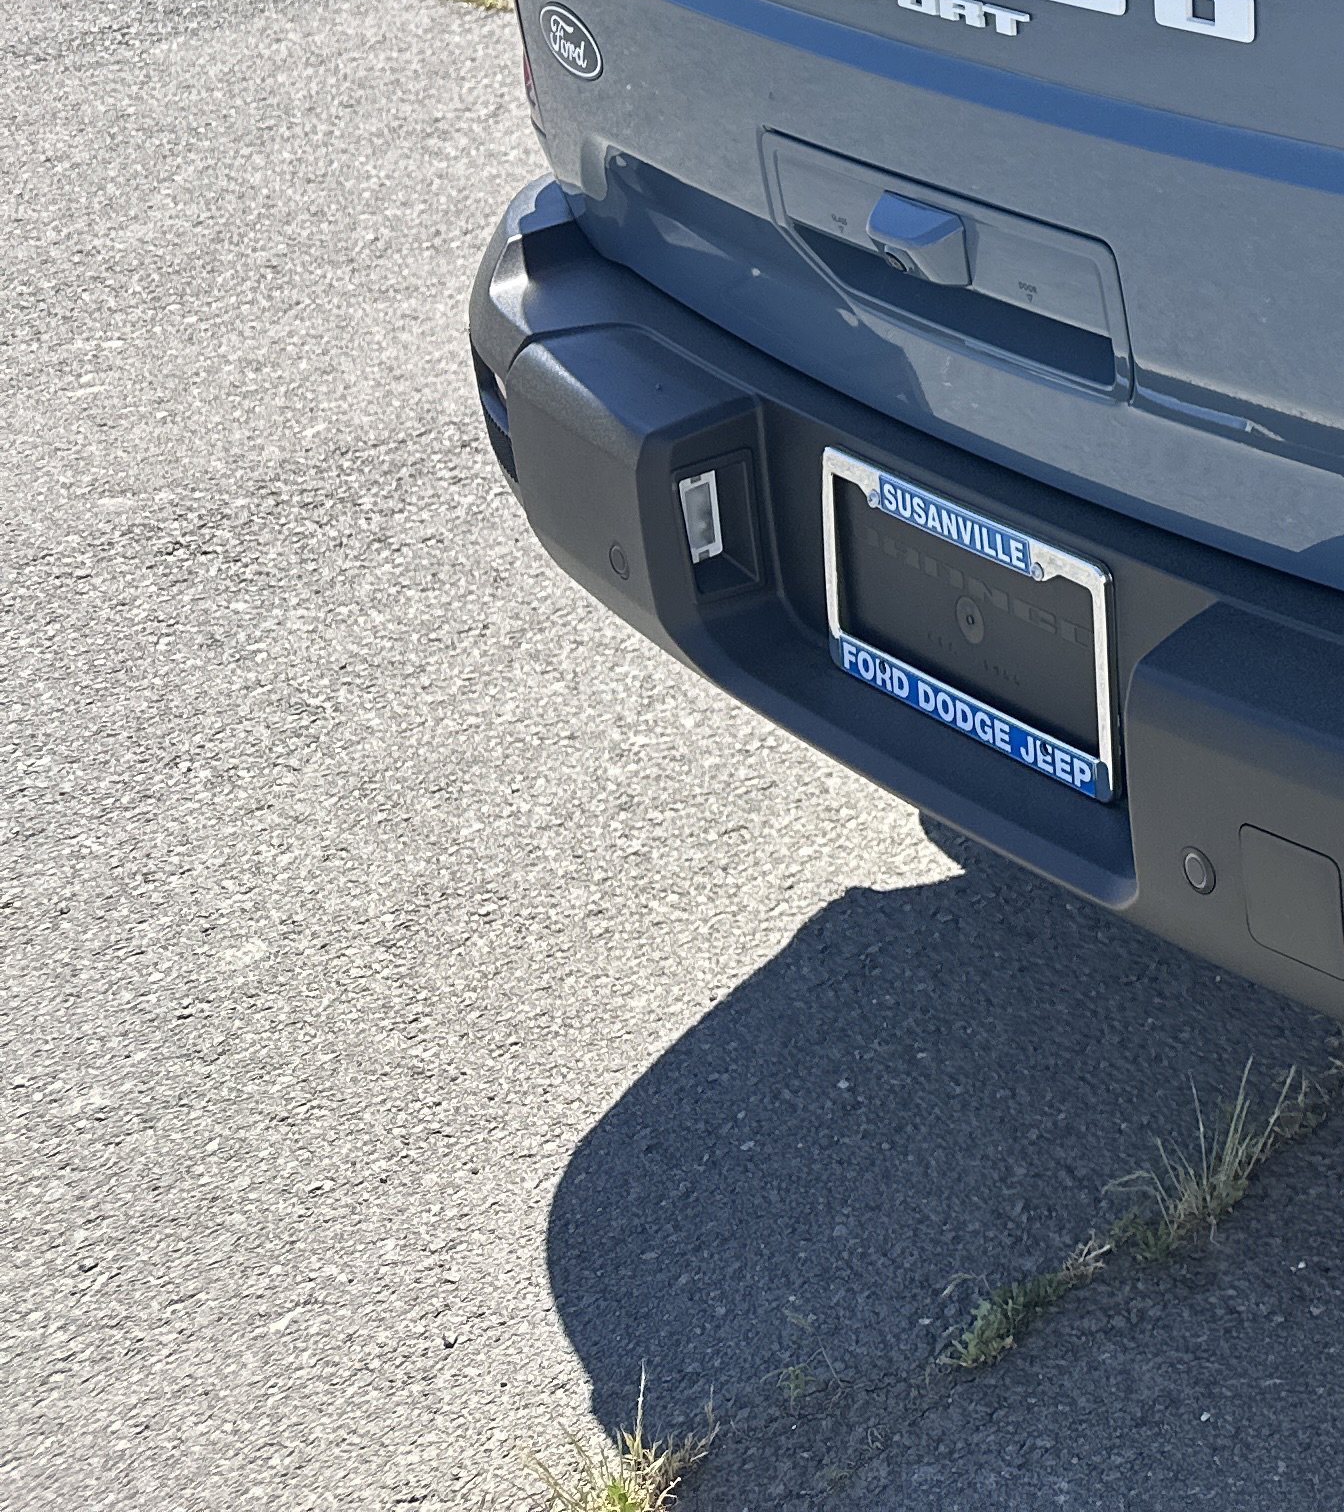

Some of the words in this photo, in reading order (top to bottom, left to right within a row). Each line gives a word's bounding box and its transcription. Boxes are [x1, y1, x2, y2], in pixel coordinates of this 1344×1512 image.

[548, 13, 589, 70] Ford
[883, 482, 1027, 570] SUSANVILLE
[842, 643, 910, 700] FORD
[917, 679, 1012, 754] DODGE
[1020, 733, 1093, 788] JEEP
